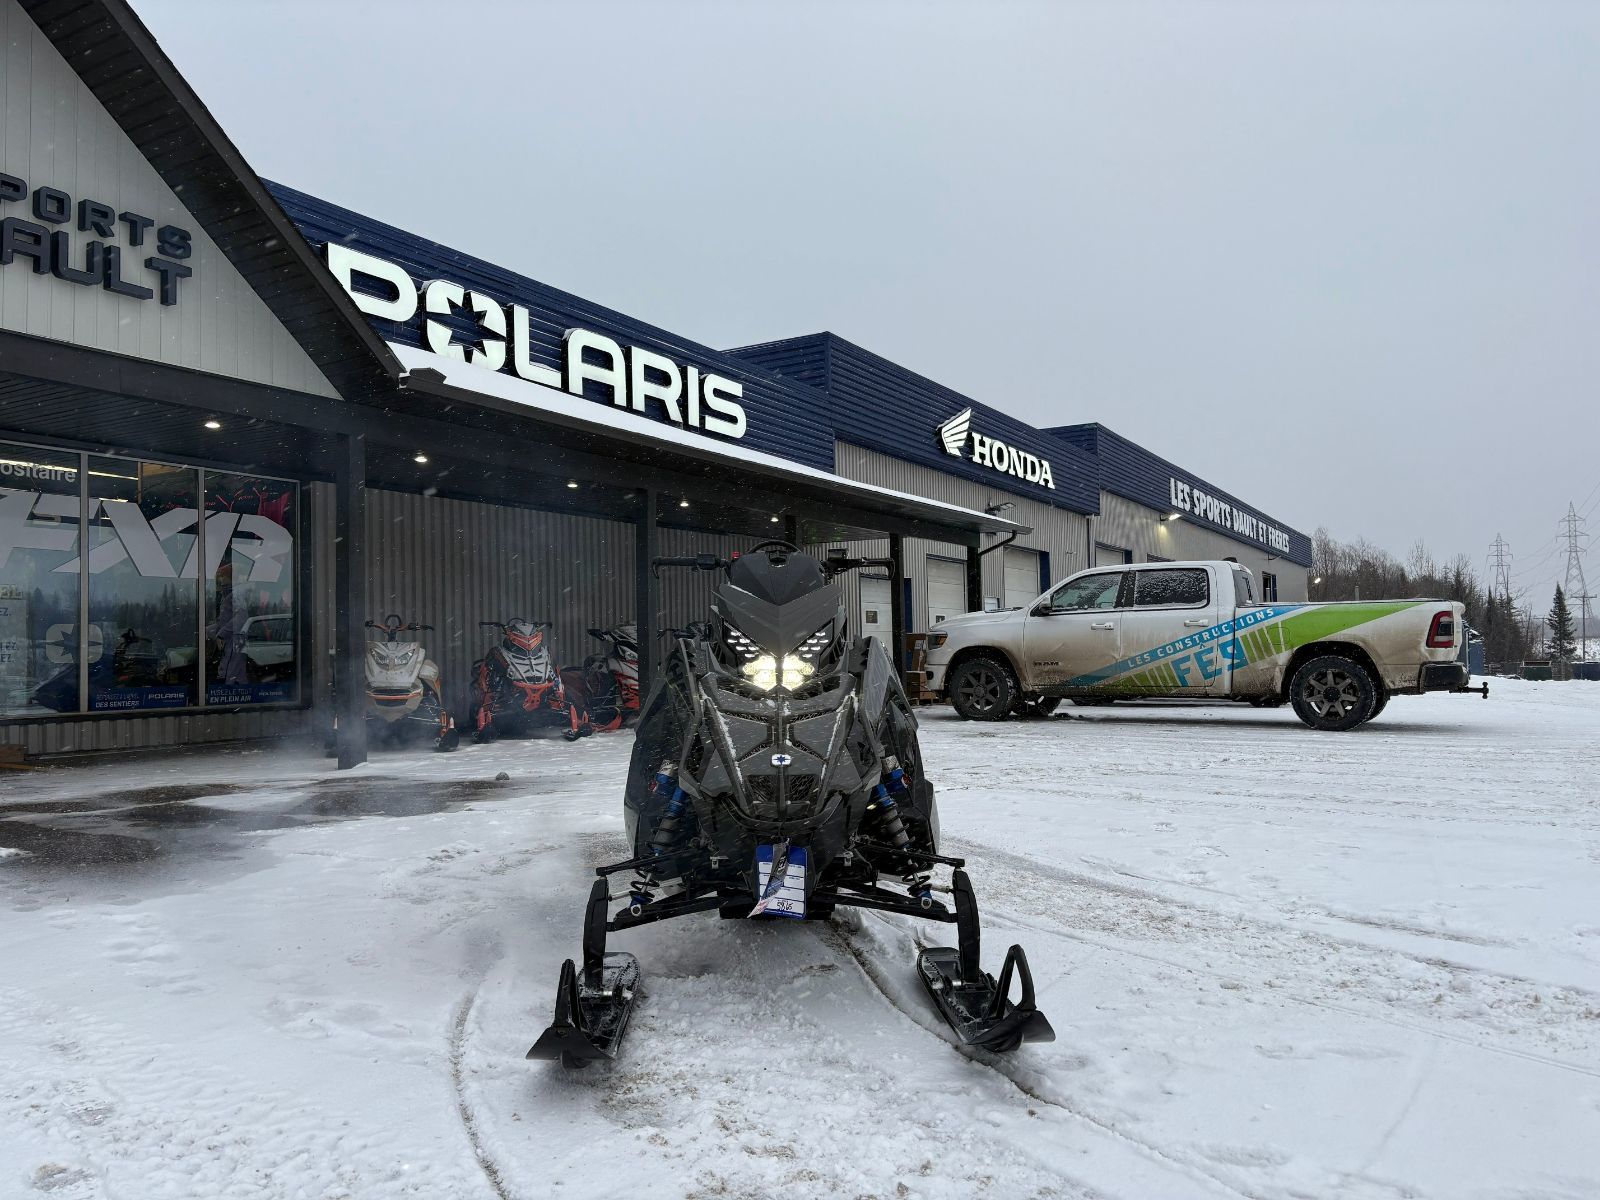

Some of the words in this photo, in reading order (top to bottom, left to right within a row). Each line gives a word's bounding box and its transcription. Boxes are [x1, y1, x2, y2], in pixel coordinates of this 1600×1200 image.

[0, 216, 192, 306] AULT
[325, 242, 747, 439] POLARIS
[971, 431, 1056, 490] HONDA
[1169, 478, 1191, 512] LES
[1193, 488, 1231, 529] SPORTS
[1232, 507, 1257, 540] DAULT
[1258, 520, 1268, 544] ET
[1127, 653, 1151, 668] LES
[1157, 608, 1274, 657] CONSTRUCTIONS
